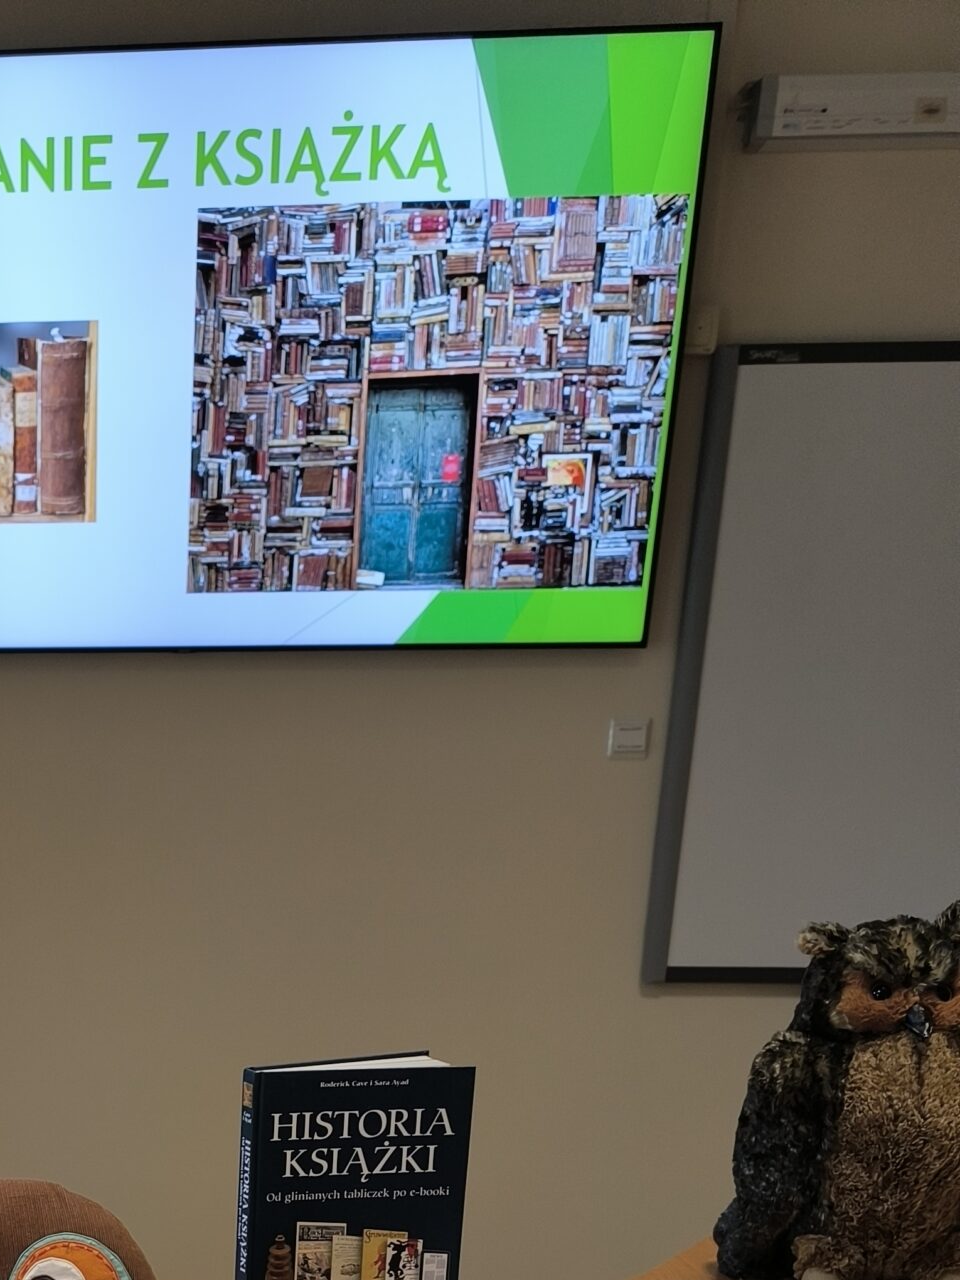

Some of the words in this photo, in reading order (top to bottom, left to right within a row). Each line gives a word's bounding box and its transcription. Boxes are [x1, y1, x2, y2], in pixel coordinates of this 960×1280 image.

[136, 132, 170, 190] Z
[195, 110, 451, 197] KSIĄŻKĄ
[320, 1080, 350, 1088] Roderick
[392, 1079, 410, 1087] Ayad
[270, 1108, 456, 1142] HISTORIA
[282, 1141, 439, 1183] KSIĄŻKI
[266, 1192, 282, 1202] Od
[284, 1190, 340, 1203] glinianych
[343, 1188, 390, 1199] tabliczek
[393, 1190, 407, 1201] po
[409, 1186, 450, 1198] e-booki
